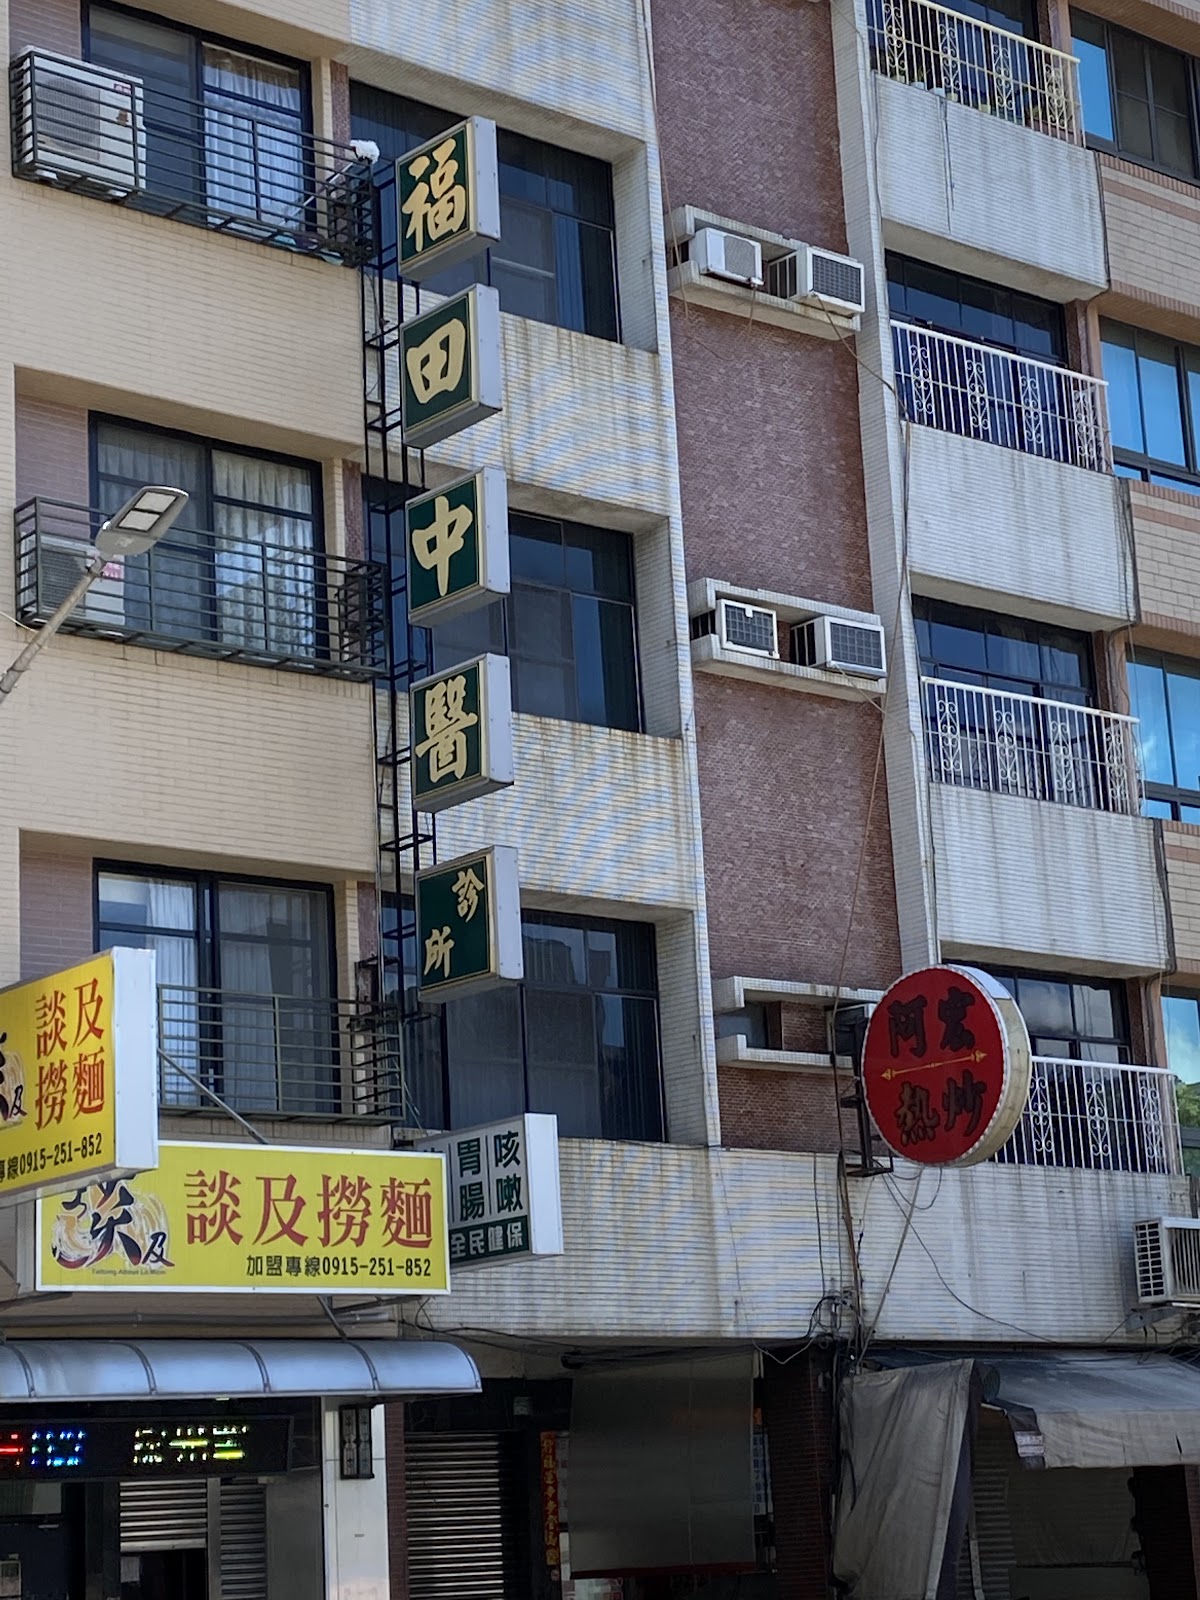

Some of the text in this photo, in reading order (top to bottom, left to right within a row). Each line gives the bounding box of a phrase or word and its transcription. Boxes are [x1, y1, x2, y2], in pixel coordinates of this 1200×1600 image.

[35, 977, 105, 1060] 談及
[35, 1046, 105, 1131] 撈麵
[894, 1068, 987, 1147] 熱炒
[184, 1169, 433, 1249] 談及撈麵
[457, 1137, 485, 1222] 胃腸
[493, 1130, 524, 1214] 咳嗽
[246, 1254, 432, 1277] 加盟專線0915-251-852
[450, 1221, 524, 1258] 全民健保
